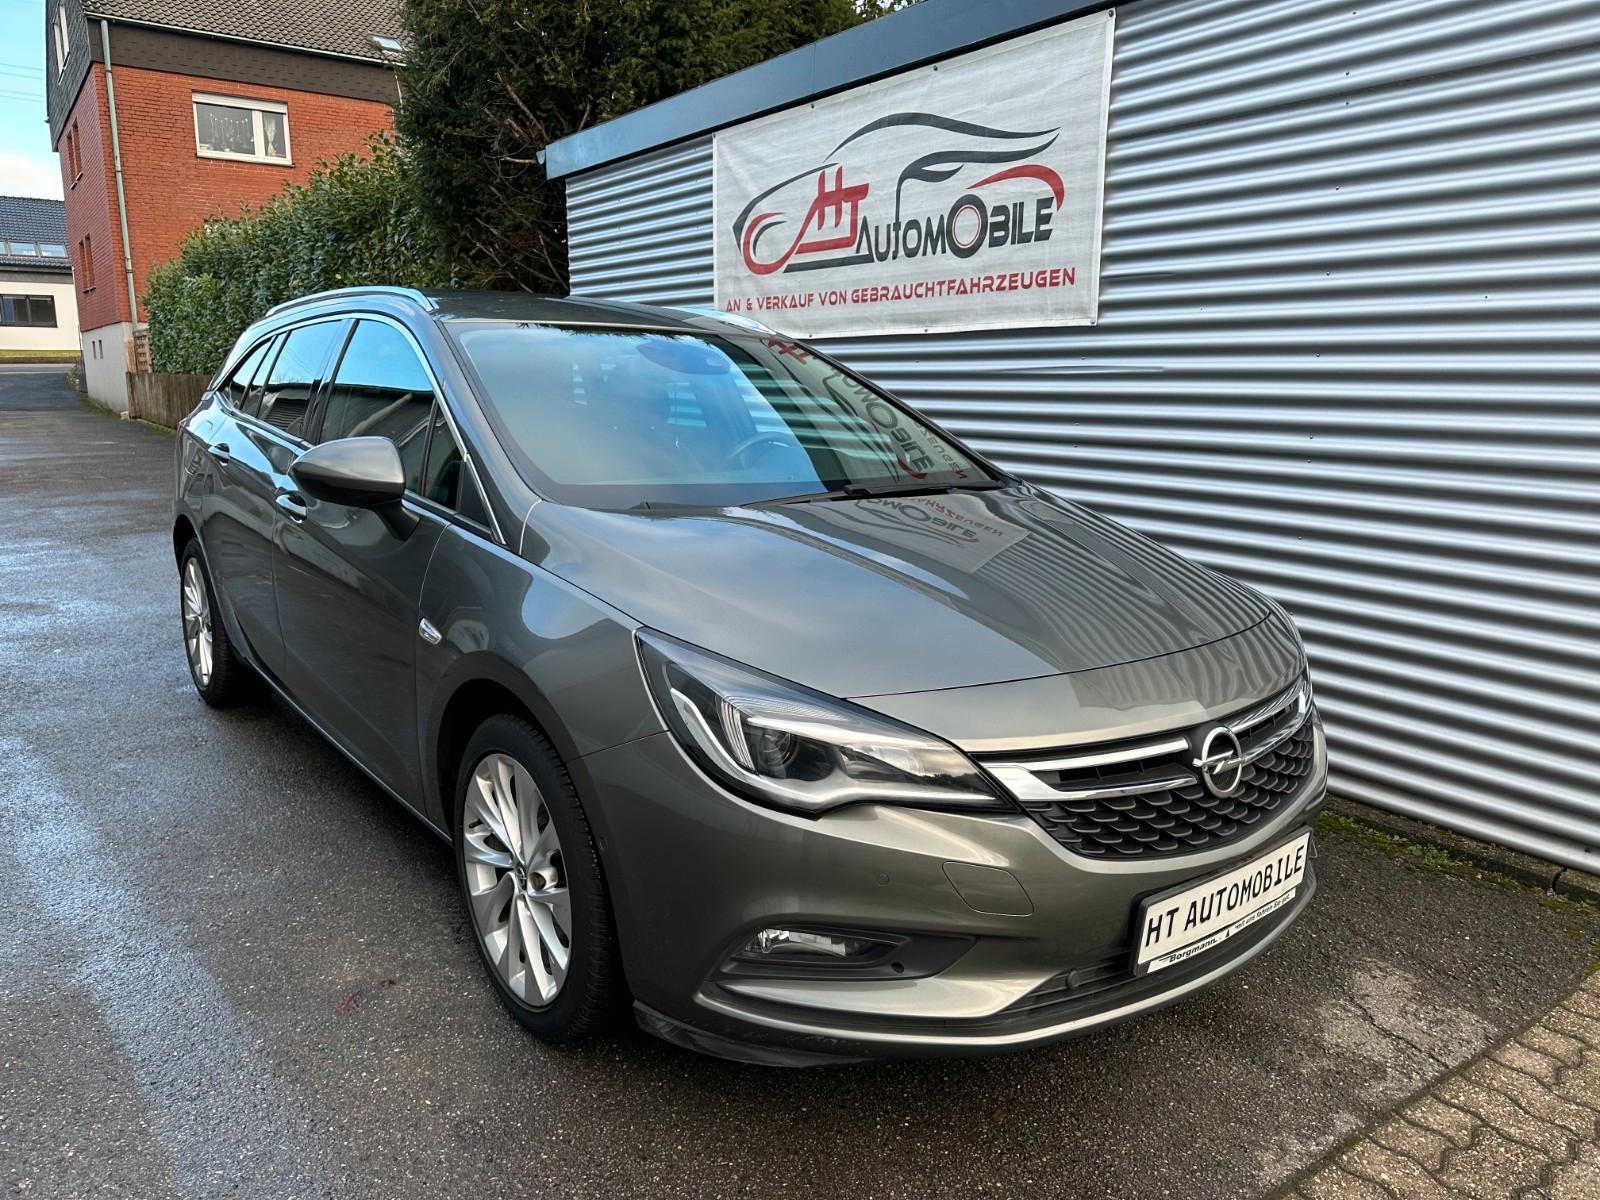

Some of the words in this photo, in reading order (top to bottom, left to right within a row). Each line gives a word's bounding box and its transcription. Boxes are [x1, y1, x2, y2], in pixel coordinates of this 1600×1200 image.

[725, 298, 741, 313] AN
[746, 297, 753, 311] &
[756, 292, 814, 311] VERKAUF
[818, 289, 847, 306] VON
[851, 267, 1076, 304] GEBRAUCHTFAHRZEUGEN
[1145, 907, 1180, 947] HT
[1183, 844, 1305, 931] AUTOMOBILE
[1169, 937, 1216, 963] Borgmann
